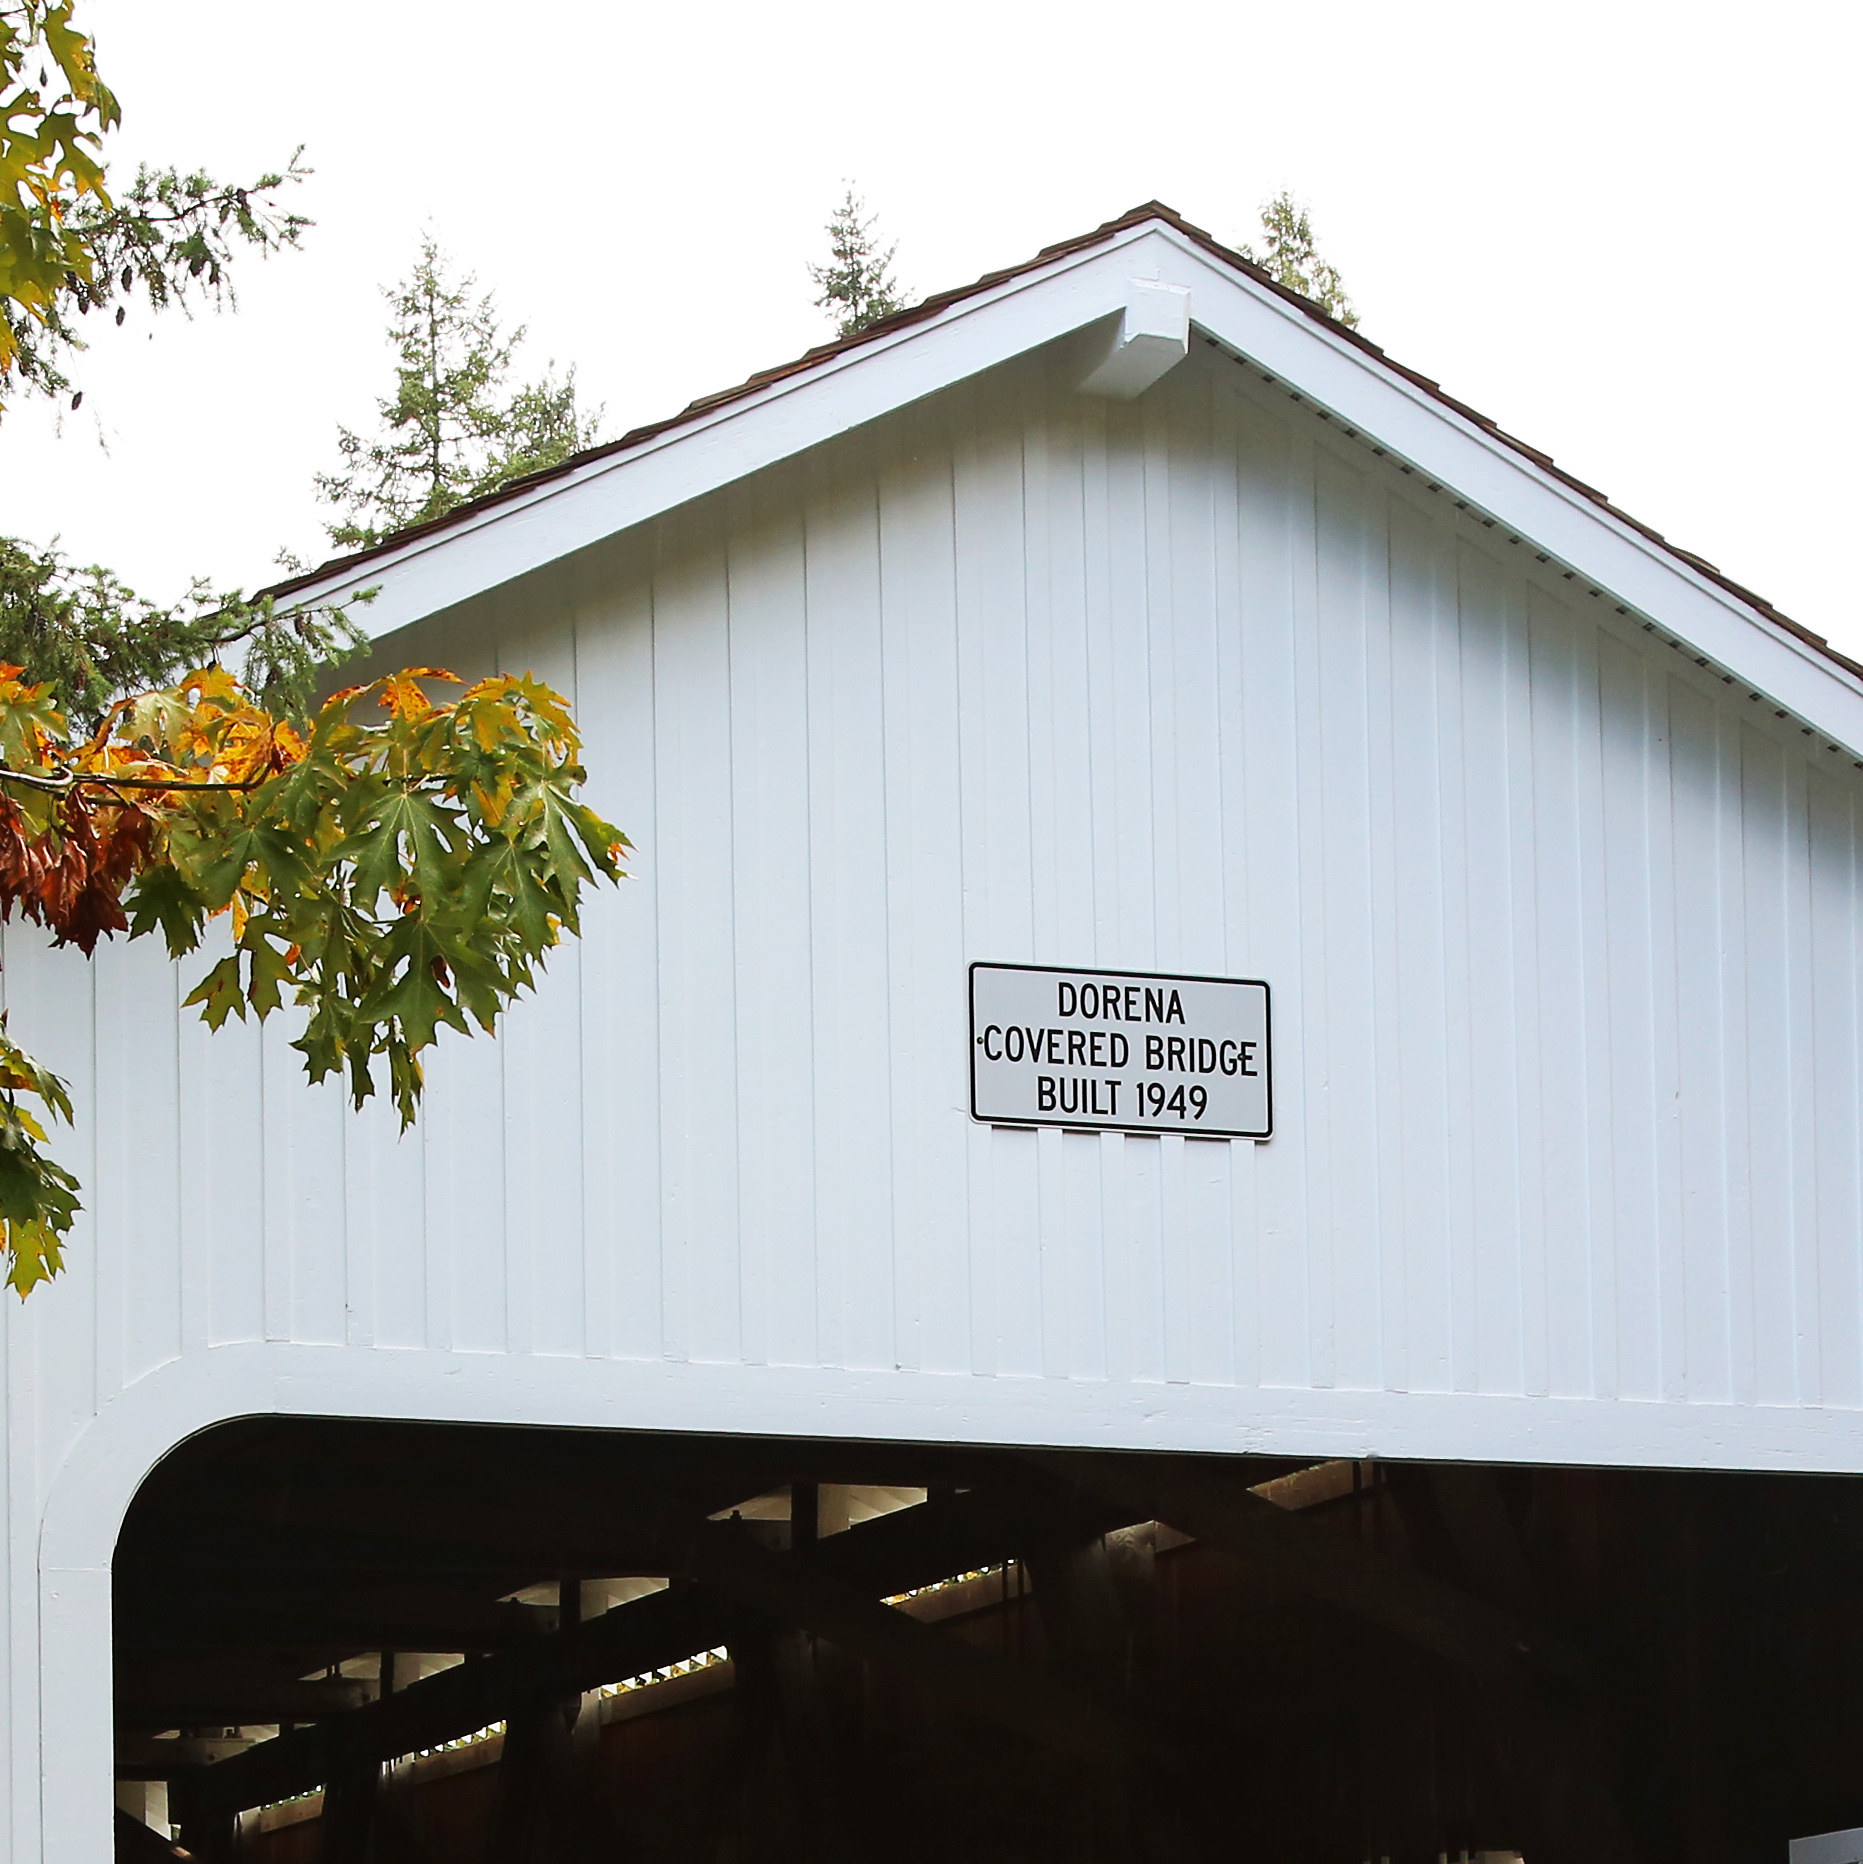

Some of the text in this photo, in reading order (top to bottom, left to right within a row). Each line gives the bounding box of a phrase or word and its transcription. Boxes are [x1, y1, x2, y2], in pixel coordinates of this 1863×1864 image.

[1058, 981, 1186, 1025] DORENA
[983, 1024, 1258, 1077] COVERED BRIDGE
[1037, 1075, 1208, 1121] BUILT 1949
